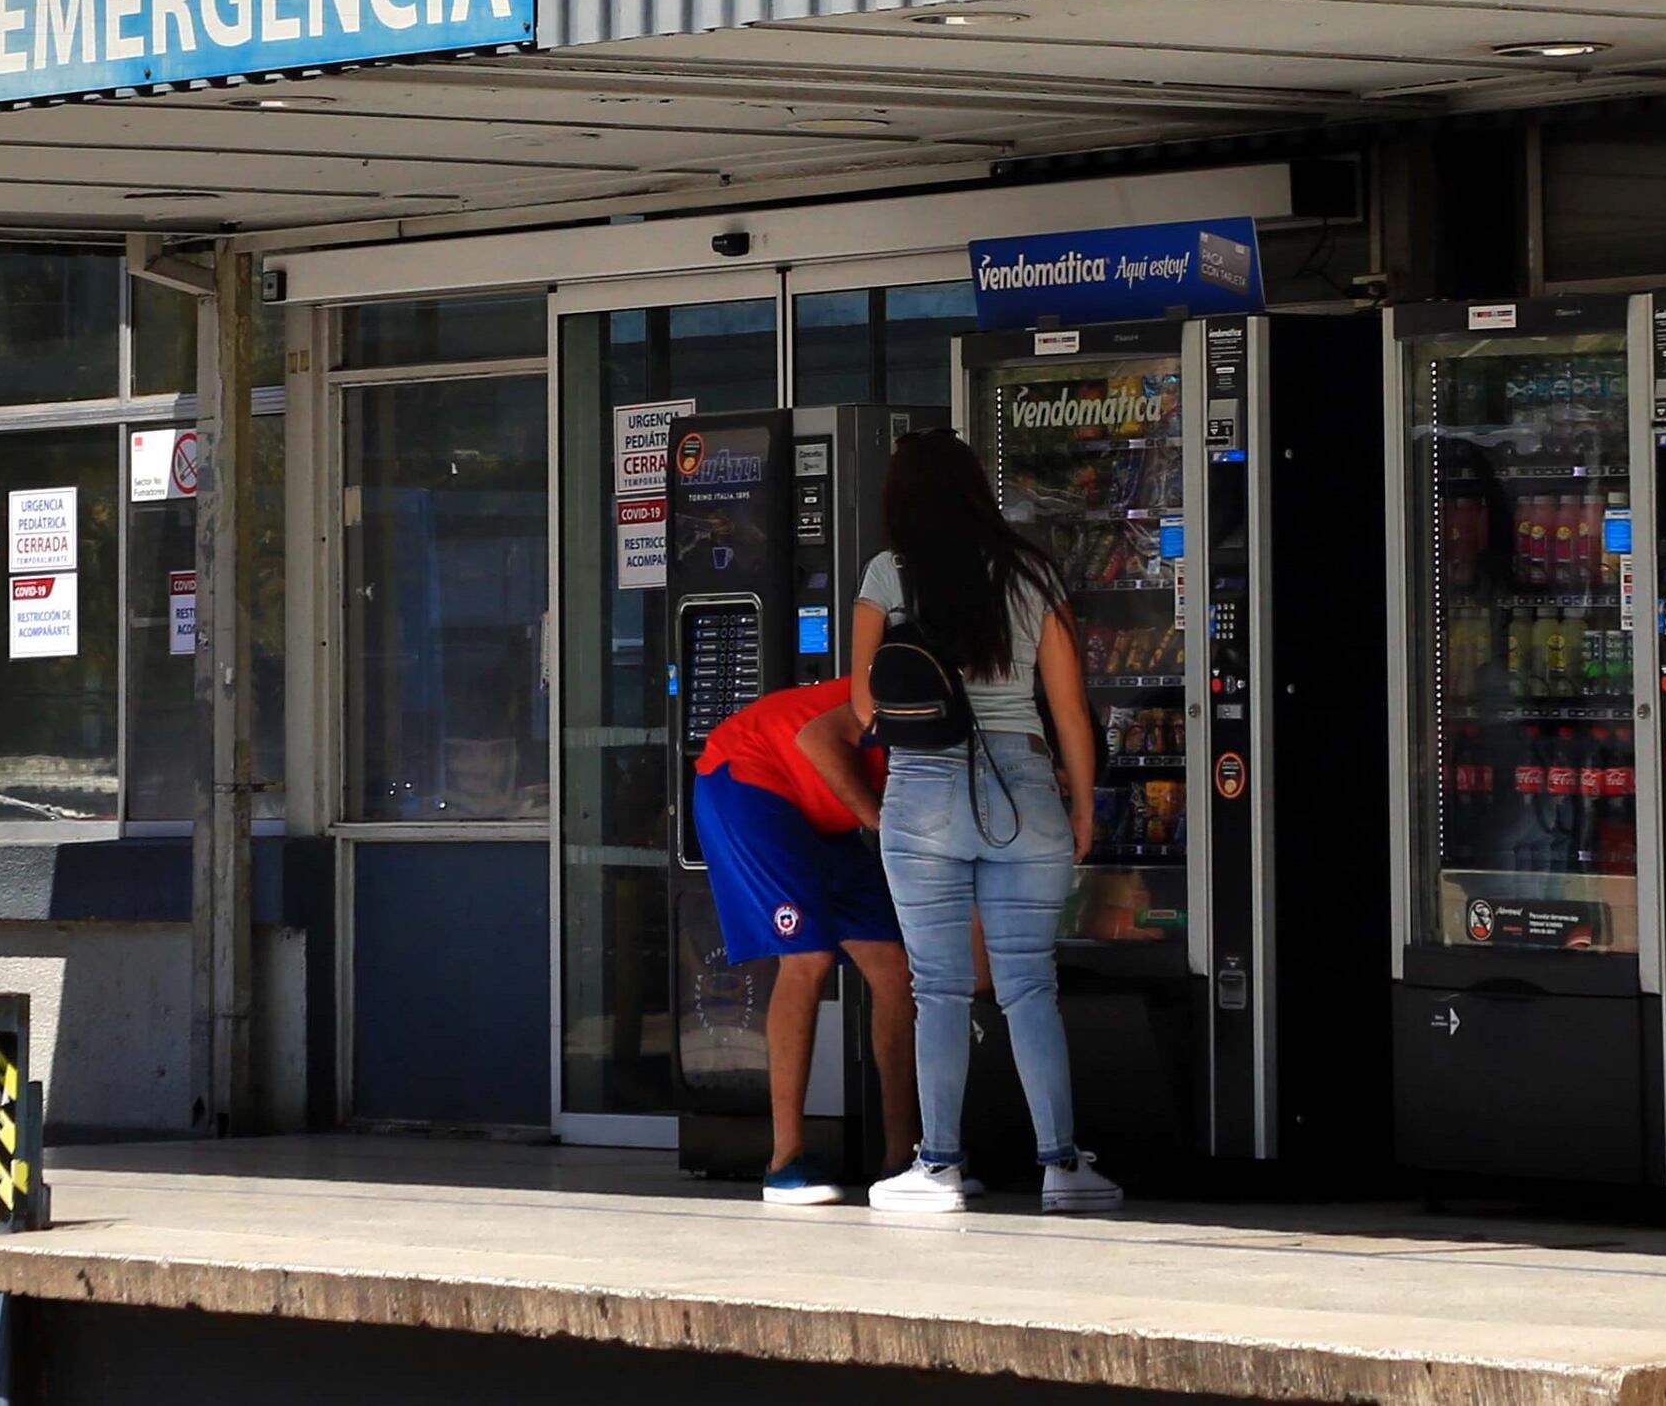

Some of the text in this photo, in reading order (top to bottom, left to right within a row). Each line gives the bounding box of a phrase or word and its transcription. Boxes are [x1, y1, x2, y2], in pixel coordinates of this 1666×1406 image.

[978, 251, 1190, 291] vendomática Aquí estoy!
[1013, 386, 1162, 428] vendomática
[629, 411, 680, 430] URGENC
[21, 498, 64, 513] URGENCIA
[621, 507, 661, 521] COVID-19
[18, 515, 67, 532] PEDIÁTRICA
[17, 536, 69, 555] CERRADA
[624, 535, 667, 551] RESTRICC
[14, 585, 47, 598] COVID-19
[62, 609, 72, 621] DE
[18, 624, 70, 638] ACOMPAÑANTE
